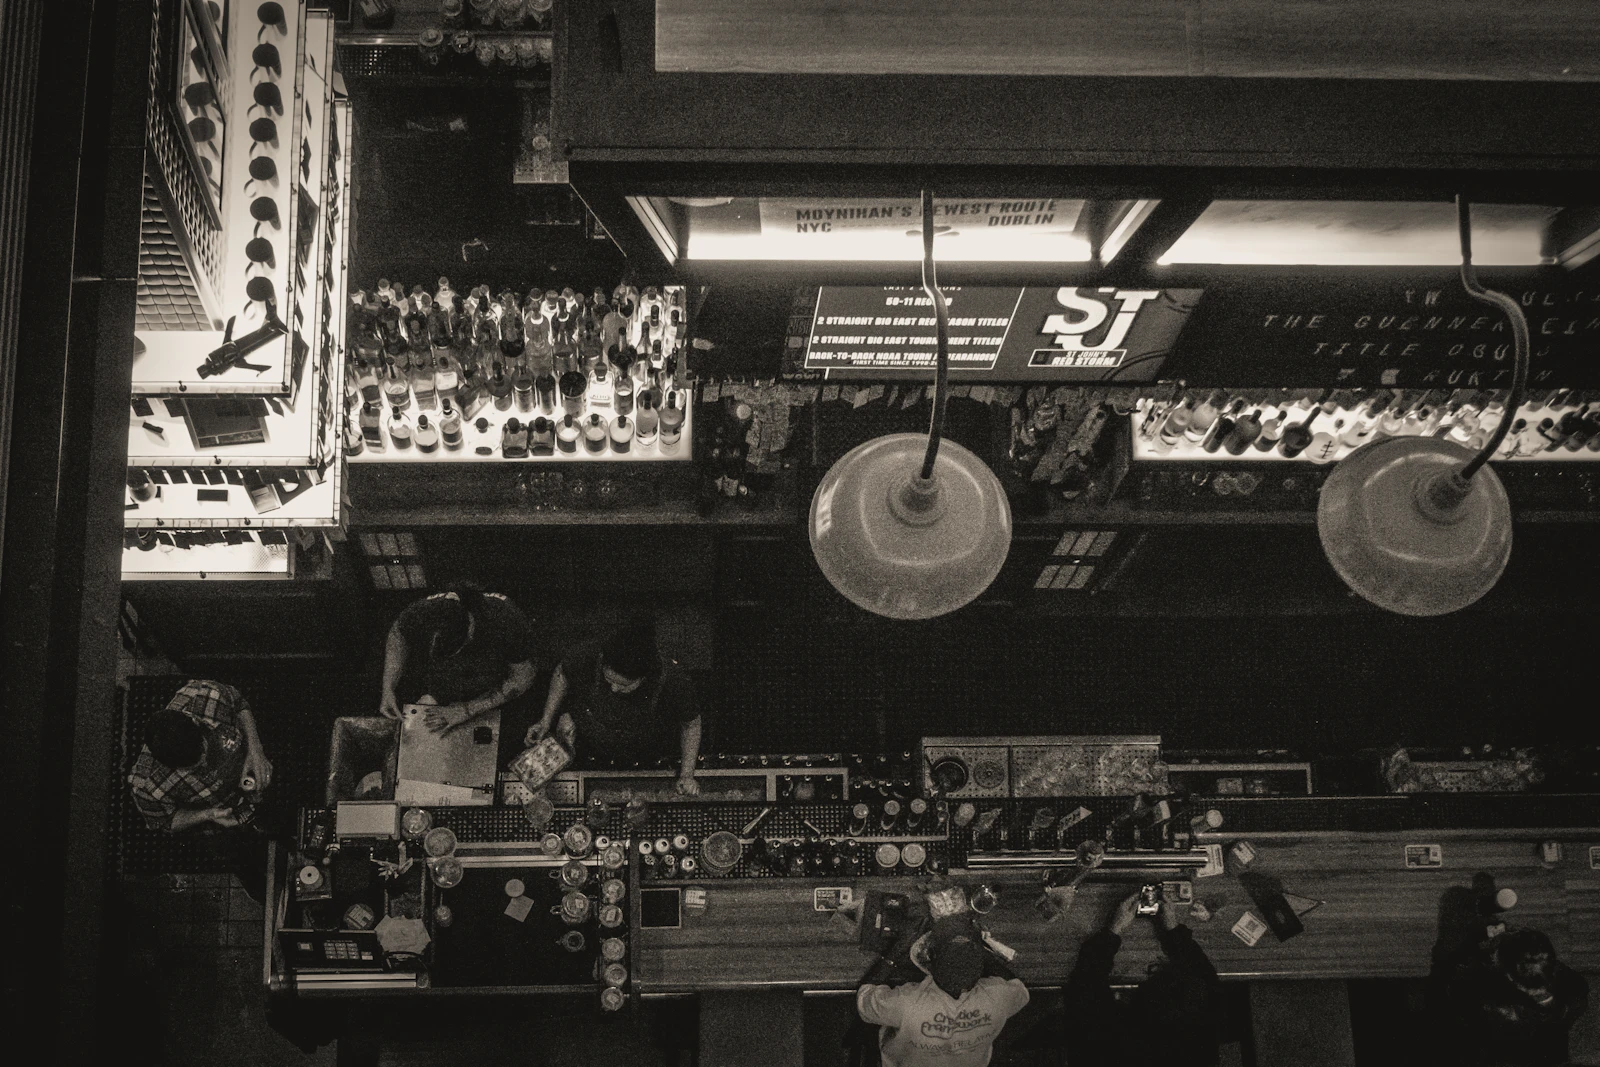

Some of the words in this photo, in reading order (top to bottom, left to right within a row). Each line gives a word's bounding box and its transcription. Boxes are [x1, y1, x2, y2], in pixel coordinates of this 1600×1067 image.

[796, 207, 912, 221] MOYNIHAN'S
[919, 203, 991, 216] EWEST
[999, 200, 1058, 213] ROUTE
[796, 222, 831, 234] NYC
[988, 213, 1054, 227] DUBLIN
[817, 316, 825, 325] 2
[826, 316, 874, 326] STRAIGHT
[893, 317, 917, 326] EAST
[977, 318, 1009, 327] TITLES
[1263, 314, 1327, 329] THE
[812, 336, 820, 344] 2
[820, 336, 866, 345] STRAIGHT
[884, 336, 907, 345] EAST
[909, 337, 971, 345] TOURNMENT
[972, 337, 1004, 346] TITLES
[1313, 342, 1421, 356] TITLE
[809, 352, 875, 361] BACK-TO-BACK
[903, 352, 931, 361] TOURN
[1052, 357, 1075, 366] RED
[1075, 357, 1116, 366] STORM
